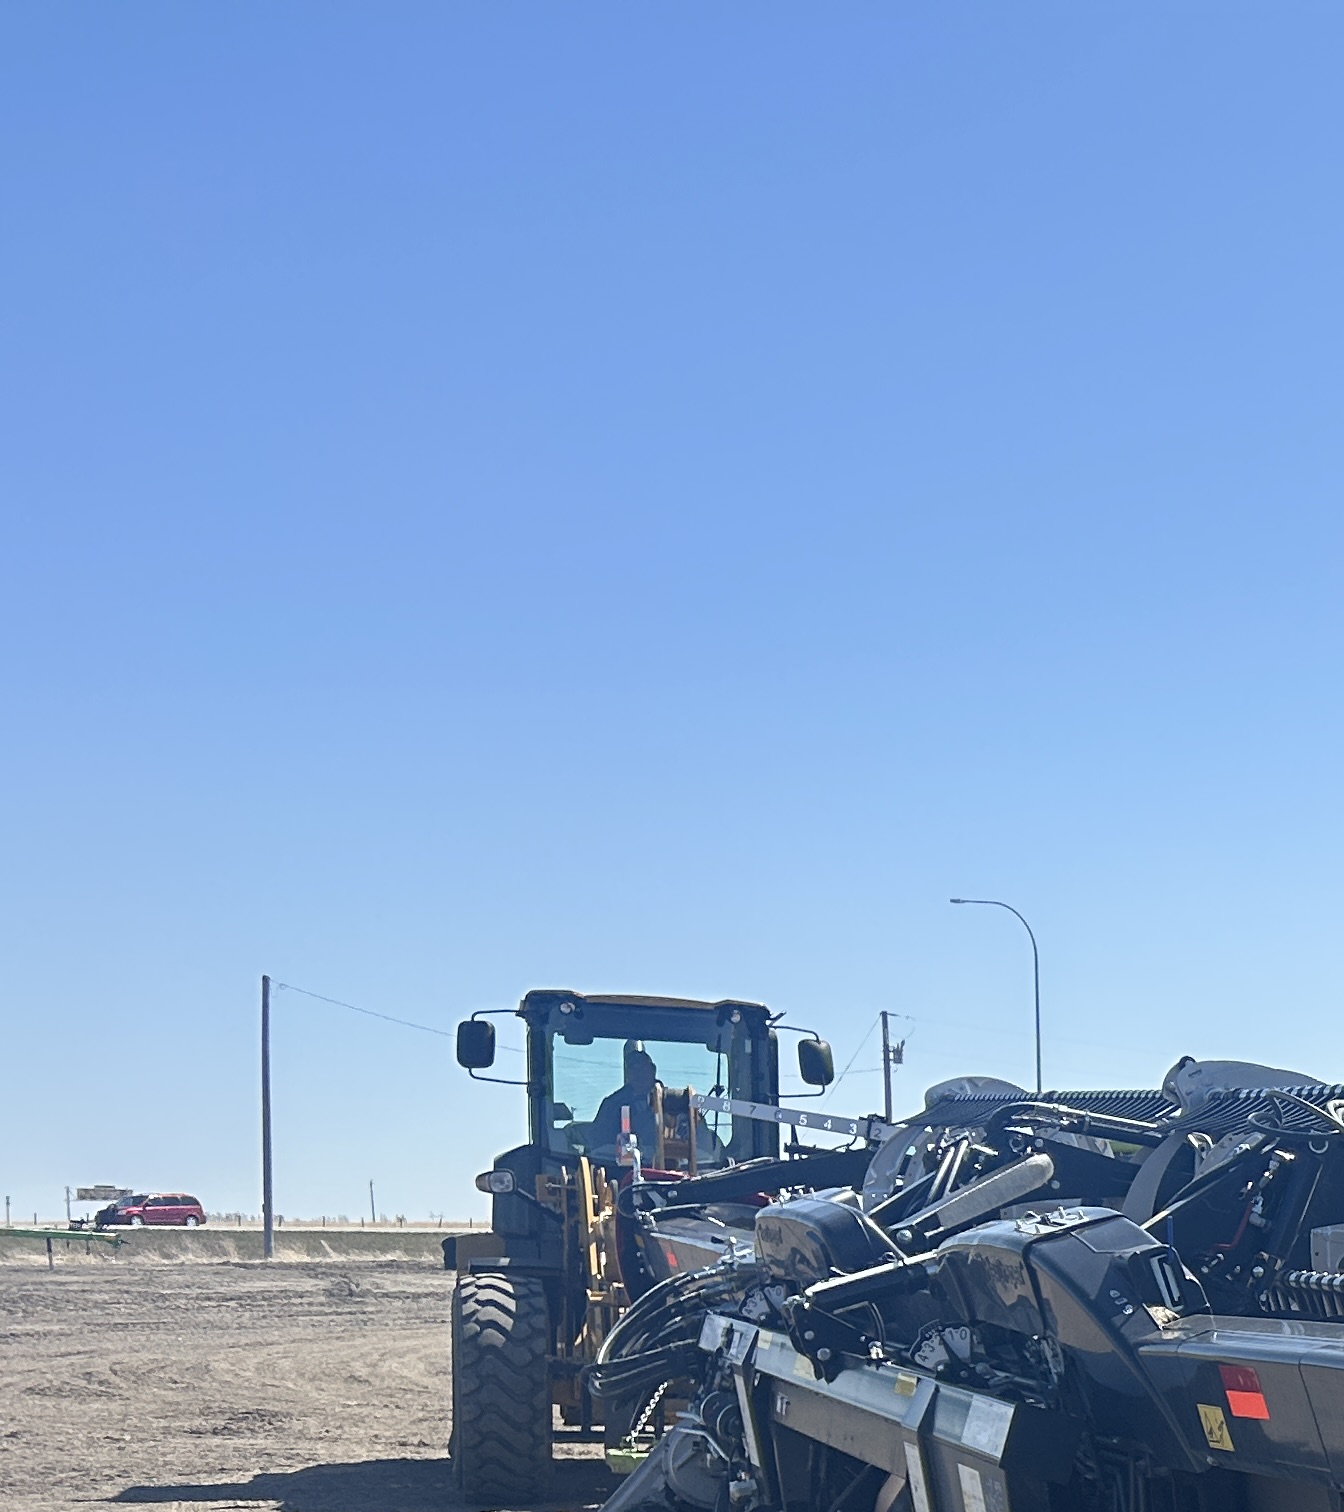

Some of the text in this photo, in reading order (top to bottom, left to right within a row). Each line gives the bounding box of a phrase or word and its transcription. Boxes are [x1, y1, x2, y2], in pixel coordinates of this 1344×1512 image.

[799, 1114, 808, 1126] 5
[823, 1119, 832, 1130] 4
[849, 1123, 858, 1135] 3
[874, 1127, 882, 1140] 2
